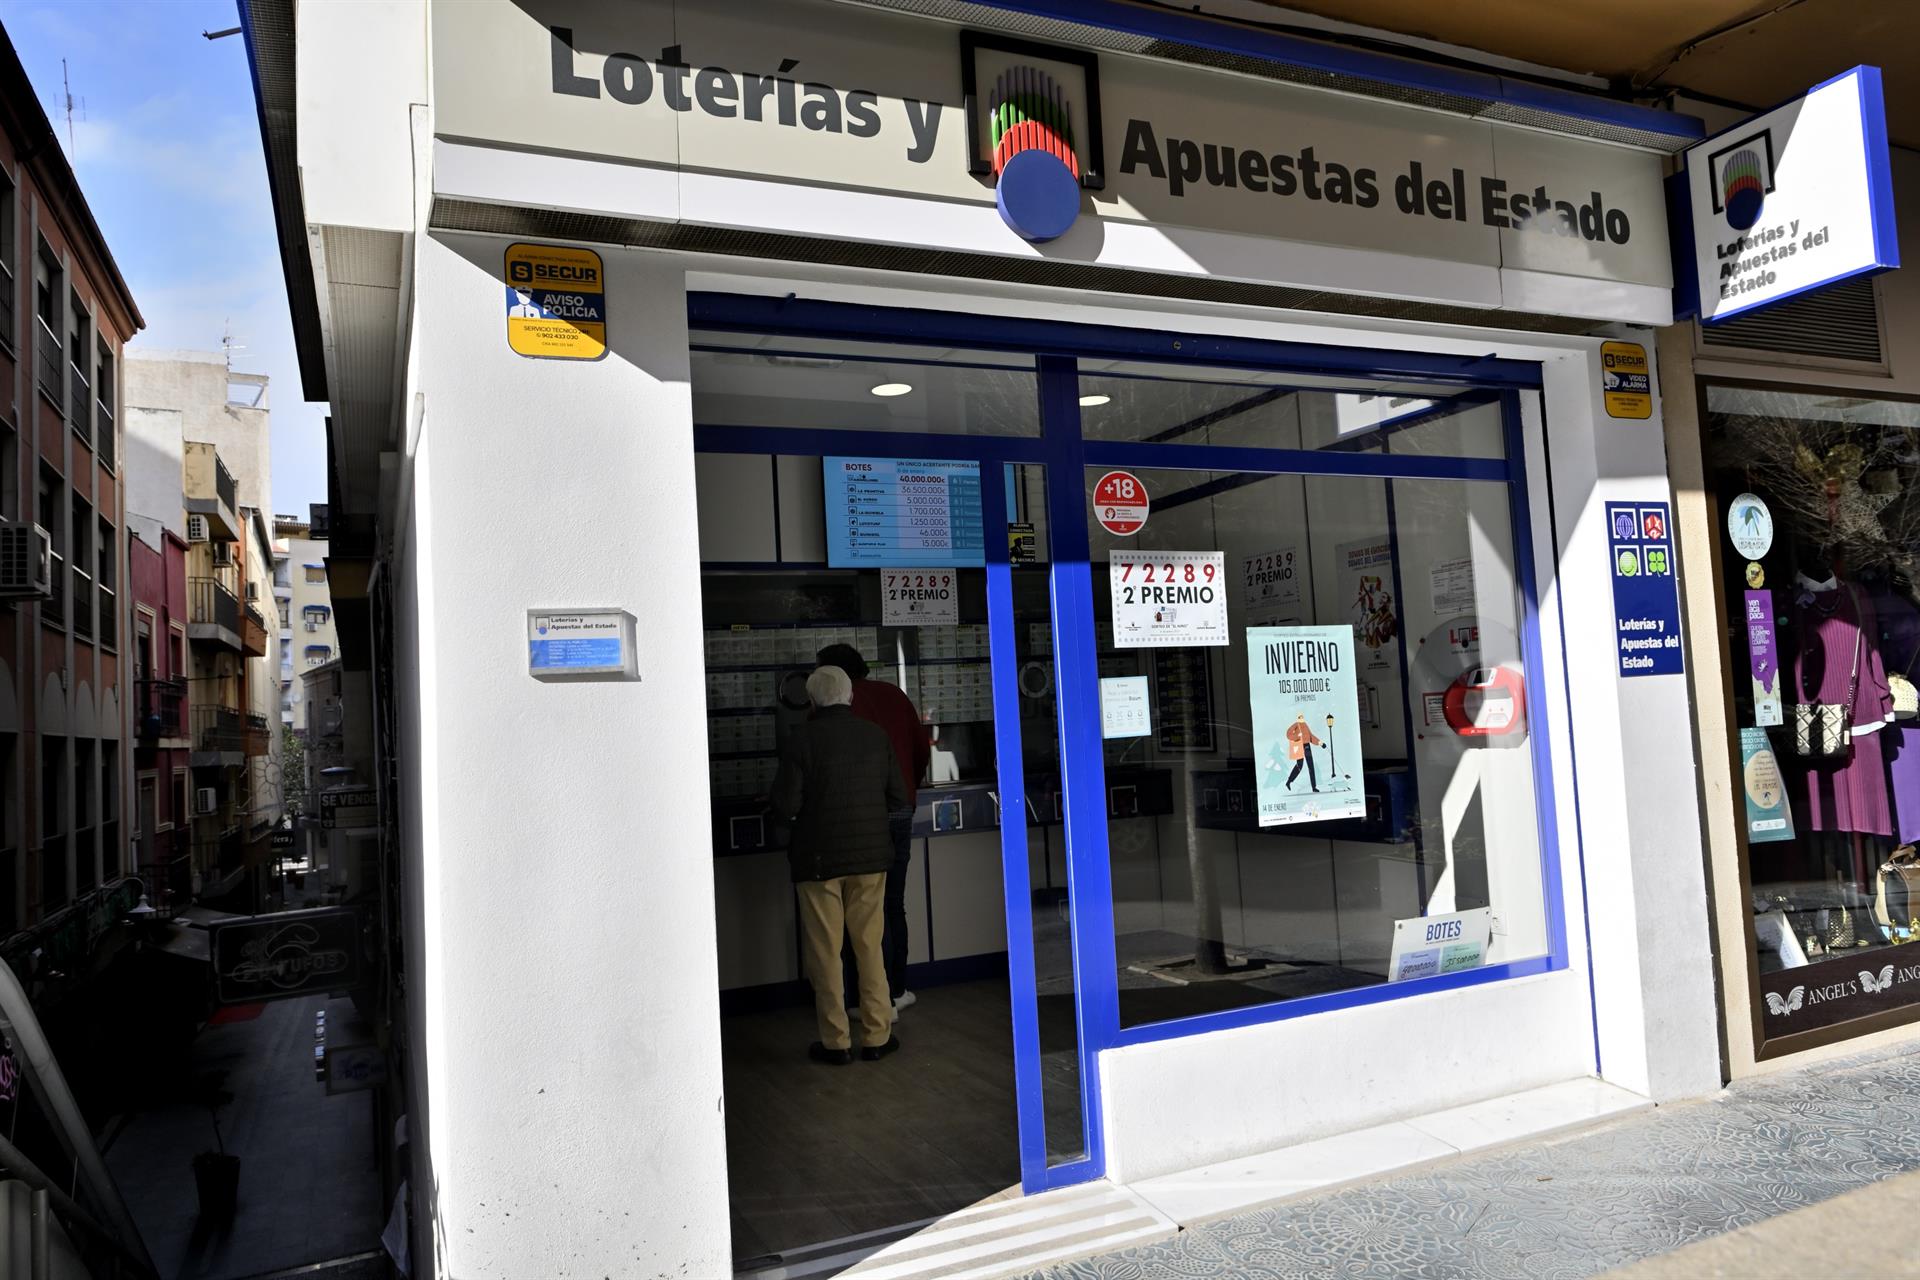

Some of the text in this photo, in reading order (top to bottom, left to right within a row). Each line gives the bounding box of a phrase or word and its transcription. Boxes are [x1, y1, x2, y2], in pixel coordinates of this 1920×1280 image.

[550, 25, 1631, 245] Loterías y Apuestas del Estado
[1717, 219, 1800, 260] Loterías y
[1720, 226, 1830, 280] Apuestas del
[535, 264, 597, 281] SECUR
[1720, 270, 1777, 300] Estado
[543, 294, 585, 307] AVISO
[543, 305, 598, 318] POLICIA
[523, 325, 551, 333] SERVICIO
[1615, 355, 1645, 368] SECUR
[1621, 381, 1648, 389] ALARMA
[1628, 374, 1647, 382] VIDEO
[845, 463, 872, 471] BOTES
[1104, 478, 1135, 499] +18
[1255, 567, 1293, 586] PREMIO
[901, 589, 949, 601] PREMIO
[1141, 586, 1214, 604] PREMIO
[1619, 617, 1664, 632] Loterías y
[1621, 635, 1679, 652] Apuestas del
[1265, 641, 1340, 674] INVIERNO
[1622, 655, 1654, 669] Estado
[1278, 677, 1331, 694] 105.000.000 €
[321, 791, 377, 807] SE VENDE
[1426, 920, 1462, 941] BOTES
